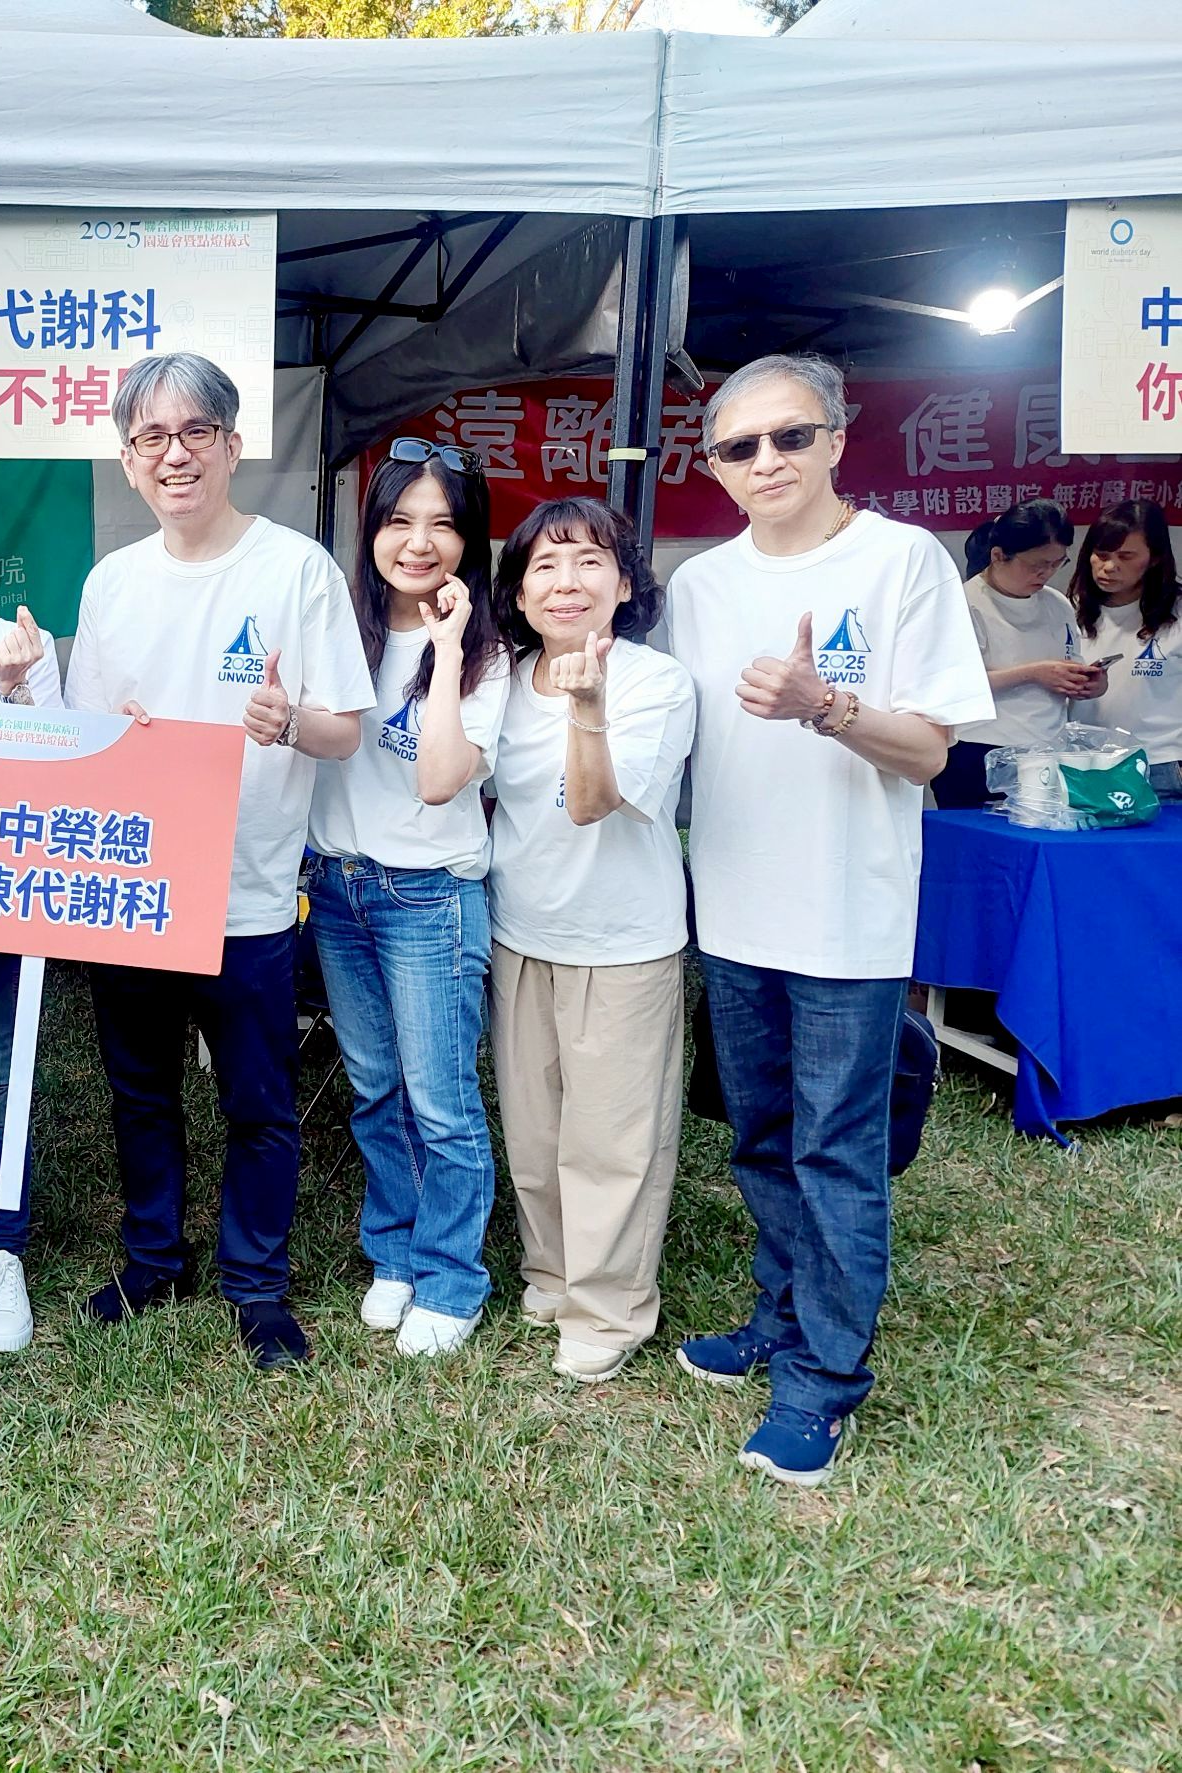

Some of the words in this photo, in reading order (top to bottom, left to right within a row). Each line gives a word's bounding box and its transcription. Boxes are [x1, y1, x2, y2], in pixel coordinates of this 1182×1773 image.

[80, 221, 142, 248] 2025
[1091, 248, 1109, 256] world
[1139, 248, 1151, 256] day
[222, 656, 264, 671] 2025
[818, 654, 866, 670] 2025
[1134, 661, 1163, 669] 2025
[218, 671, 265, 684] UNWDD
[381, 727, 418, 749] 2025
[378, 738, 418, 762] UNWDD
